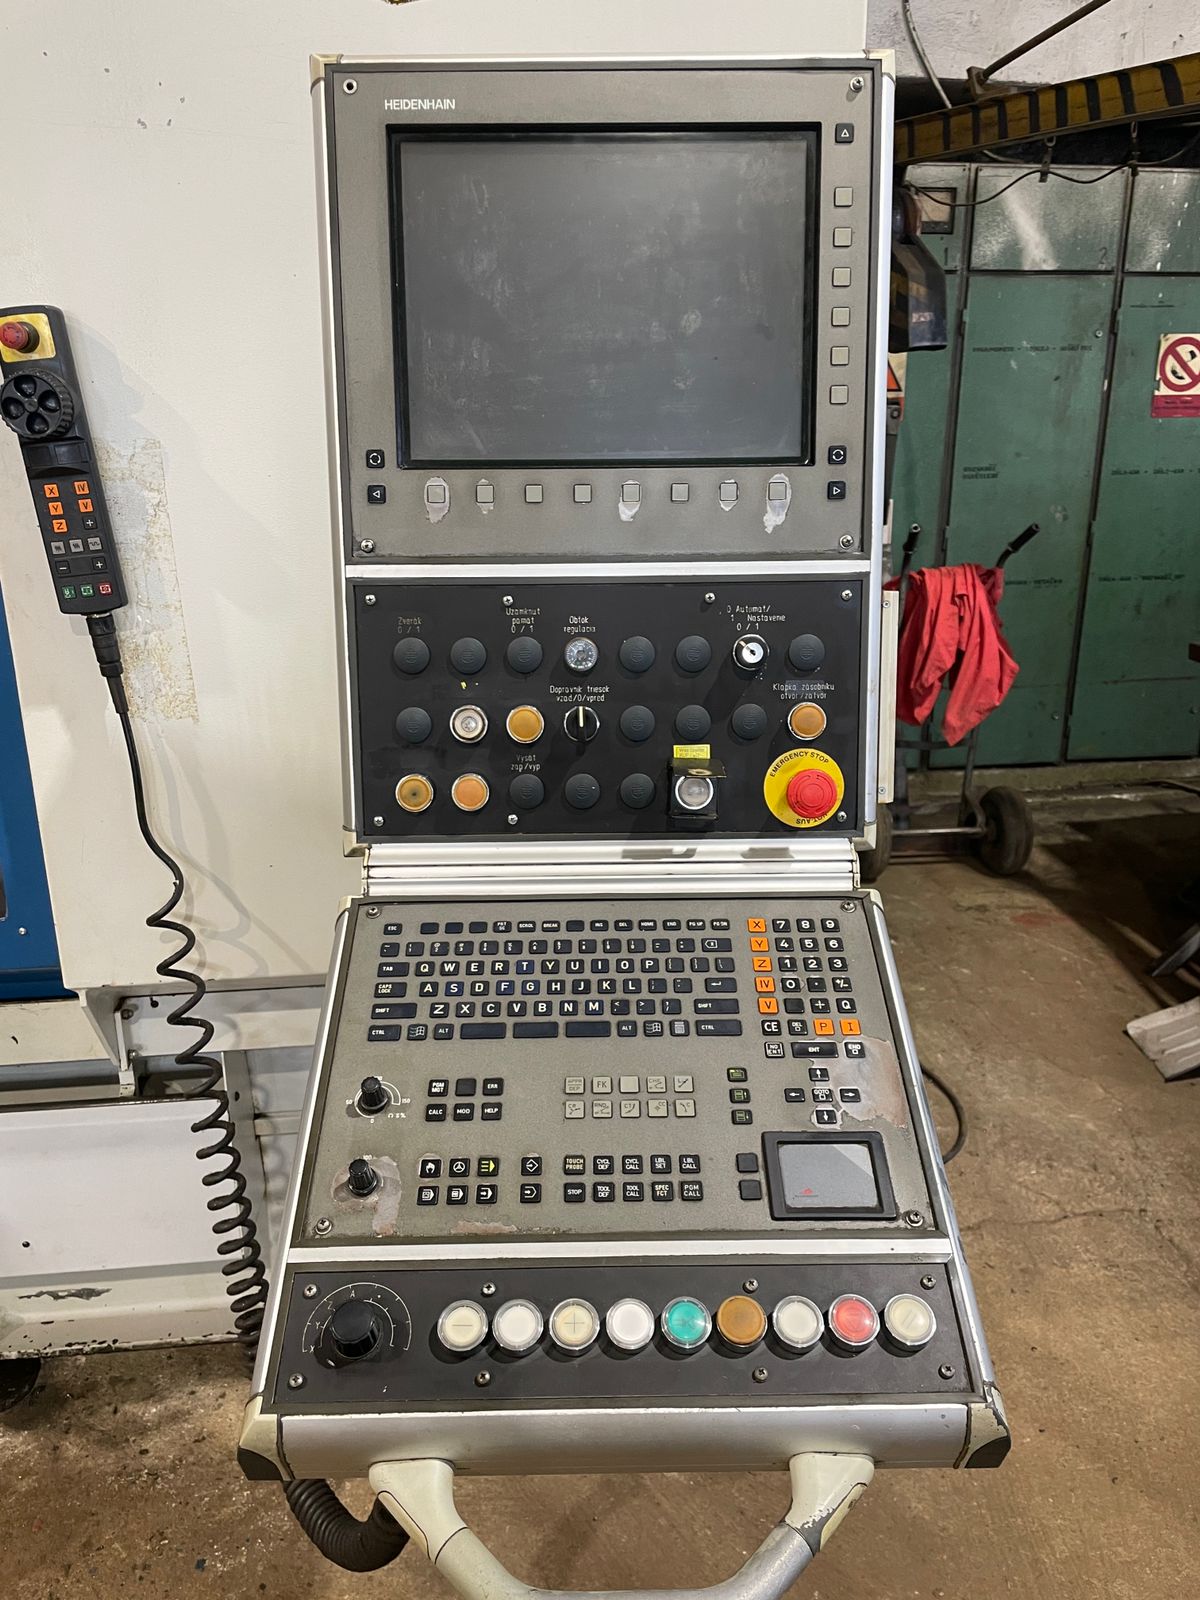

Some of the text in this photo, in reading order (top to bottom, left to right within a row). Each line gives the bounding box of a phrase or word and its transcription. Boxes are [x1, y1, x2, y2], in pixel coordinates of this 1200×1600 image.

[384, 99, 456, 110] HEIDENHAIN
[48, 486, 55, 496] X
[77, 483, 86, 492] IV
[52, 504, 59, 513] Y
[82, 502, 89, 511] V
[56, 522, 64, 530] Z
[511, 625, 516, 633] 0
[737, 623, 742, 631] 0
[770, 752, 829, 777] EMERGENCY STOP
[753, 921, 761, 929] X
[777, 921, 785, 929] 7
[802, 920, 810, 928] 8
[826, 920, 834, 928] 9
[780, 940, 789, 948] 4
[805, 940, 813, 948] 5
[830, 940, 838, 948] 6
[471, 963, 478, 971] E
[495, 962, 503, 971] R
[522, 962, 528, 970] T
[546, 962, 554, 970] Y
[571, 962, 579, 970] U
[621, 961, 629, 969] O
[646, 960, 653, 968] P
[784, 959, 790, 967] 1
[808, 960, 818, 968] 2
[834, 959, 842, 967] 3
[421, 964, 428, 972] Q
[444, 963, 455, 972] W
[424, 984, 432, 992] A
[450, 984, 458, 992] S
[476, 983, 483, 992] D
[501, 983, 509, 991] F
[526, 982, 534, 991] G
[552, 982, 560, 991] H
[578, 982, 584, 990] J
[603, 981, 610, 989] K
[629, 981, 635, 989] L
[760, 980, 769, 988] IV
[786, 980, 795, 988] 0
[461, 1004, 470, 1013] X
[487, 1004, 495, 1013] C
[513, 1004, 520, 1012] V
[539, 1003, 546, 1012] B
[564, 1003, 572, 1011] N
[589, 1002, 598, 1011] M
[765, 1001, 771, 1009] V
[842, 1000, 851, 1009] Q
[434, 1005, 444, 1014] Z
[764, 1022, 778, 1031] CE
[820, 1022, 827, 1031] P
[848, 1022, 853, 1031] I
[310, 1345, 315, 1353] X
